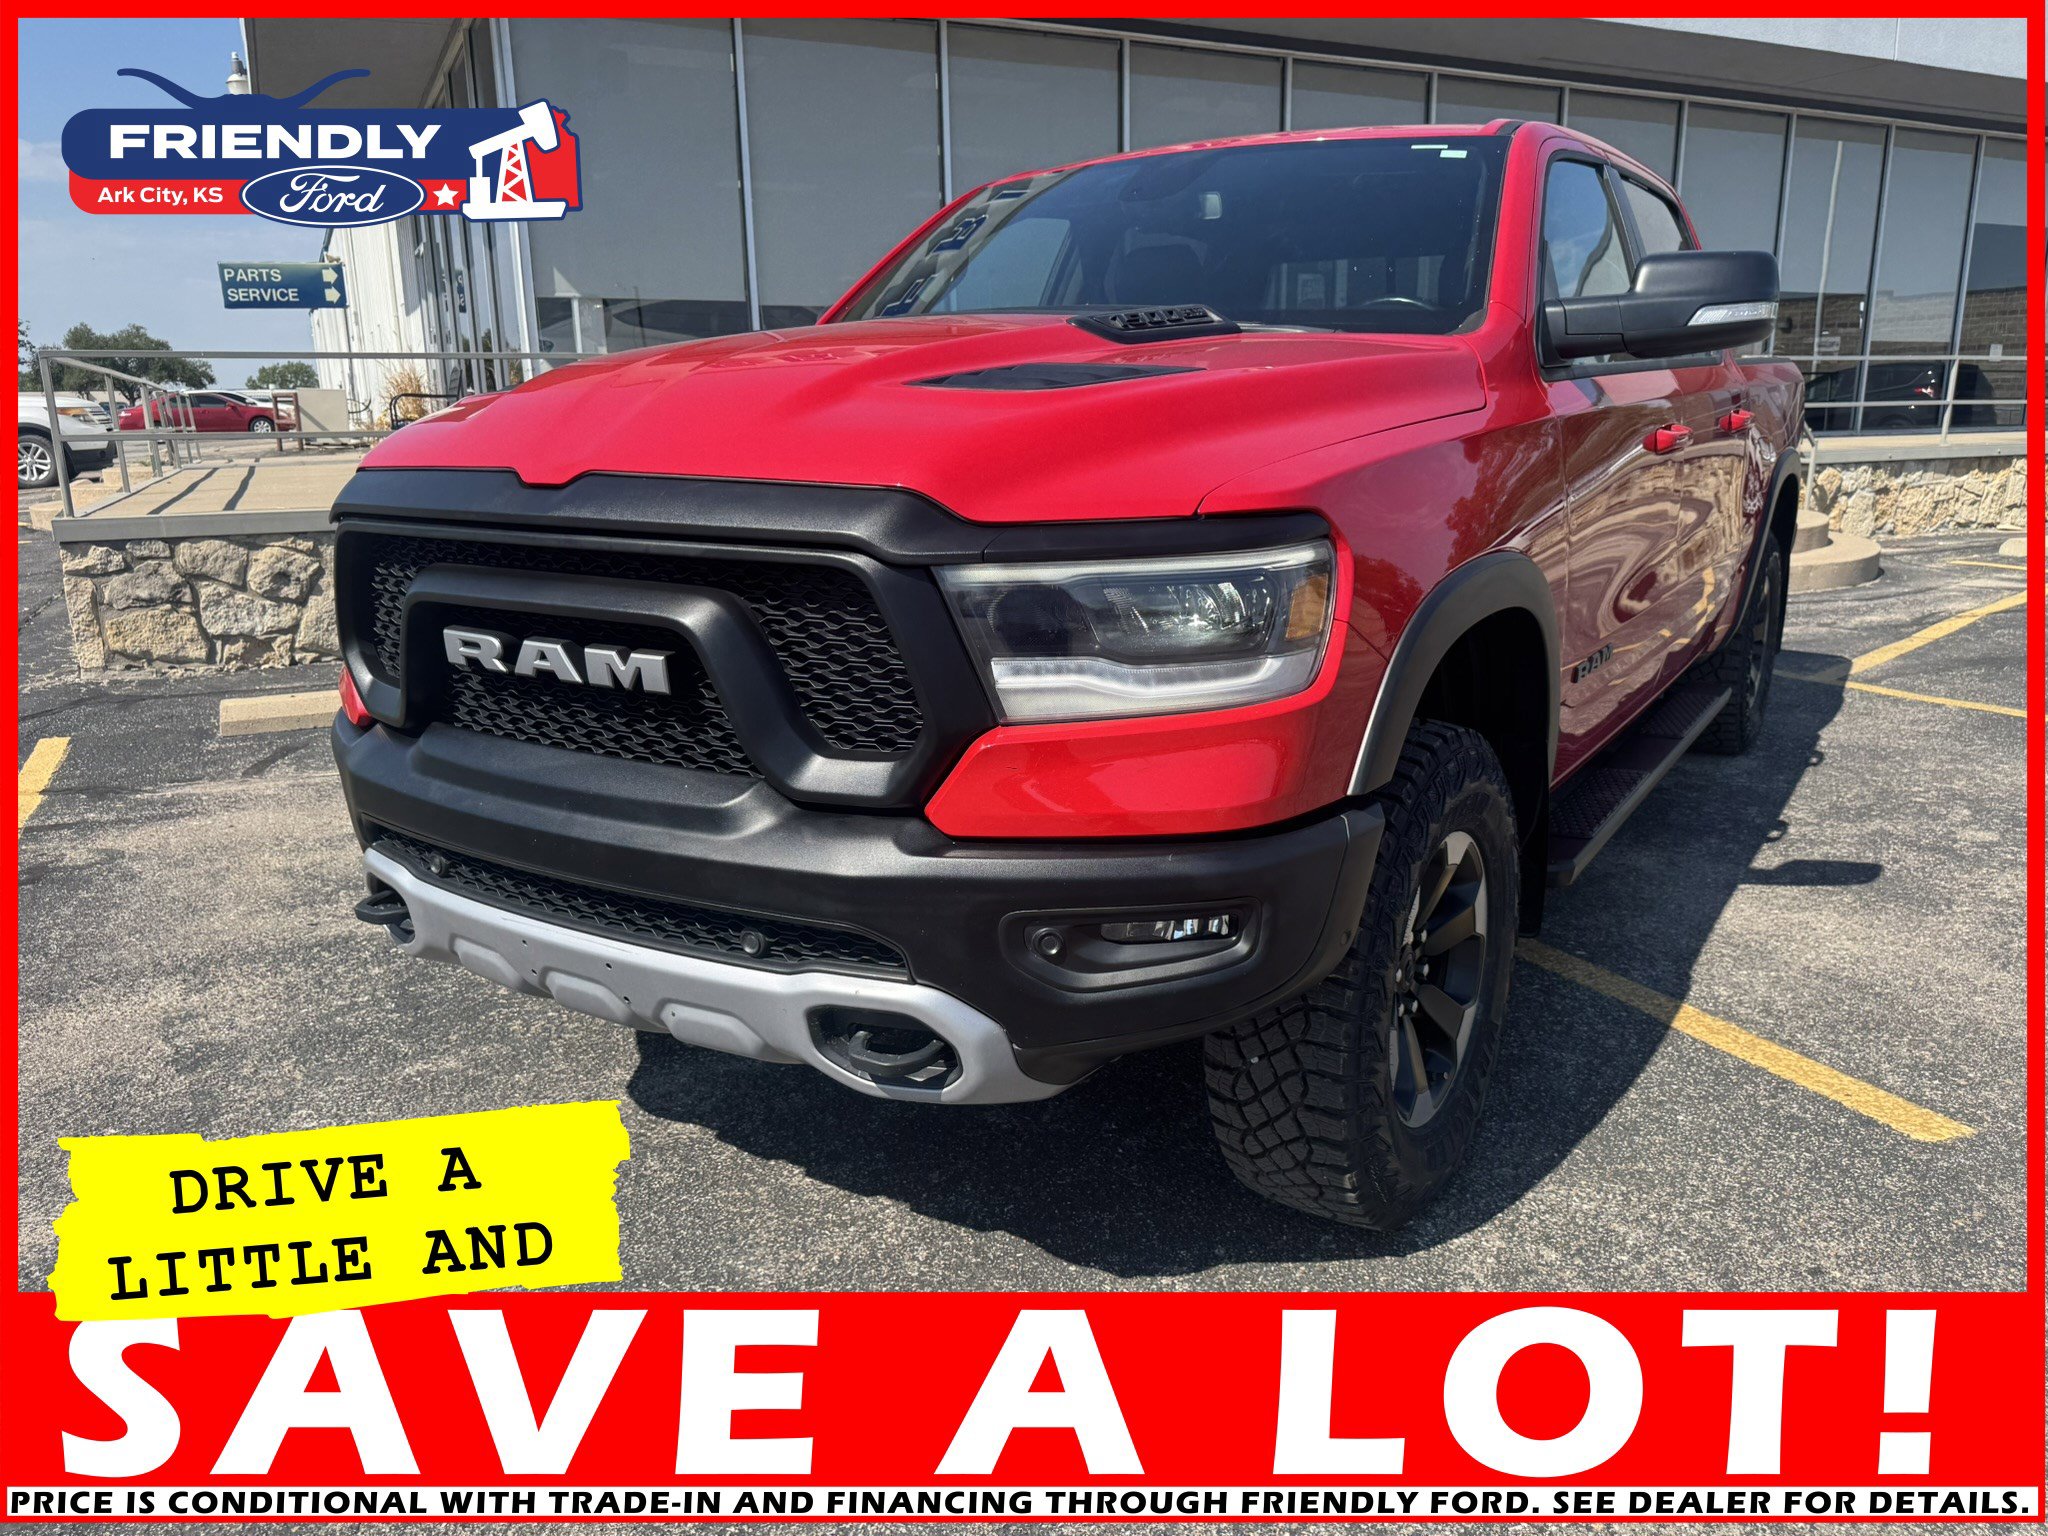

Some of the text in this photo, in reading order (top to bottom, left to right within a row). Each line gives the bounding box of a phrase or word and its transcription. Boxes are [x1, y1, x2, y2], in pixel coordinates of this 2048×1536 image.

[223, 268, 282, 282] PARTS
[227, 288, 300, 302] SERVICE
[443, 625, 677, 695] RAM
[1570, 642, 1613, 684] RAM
